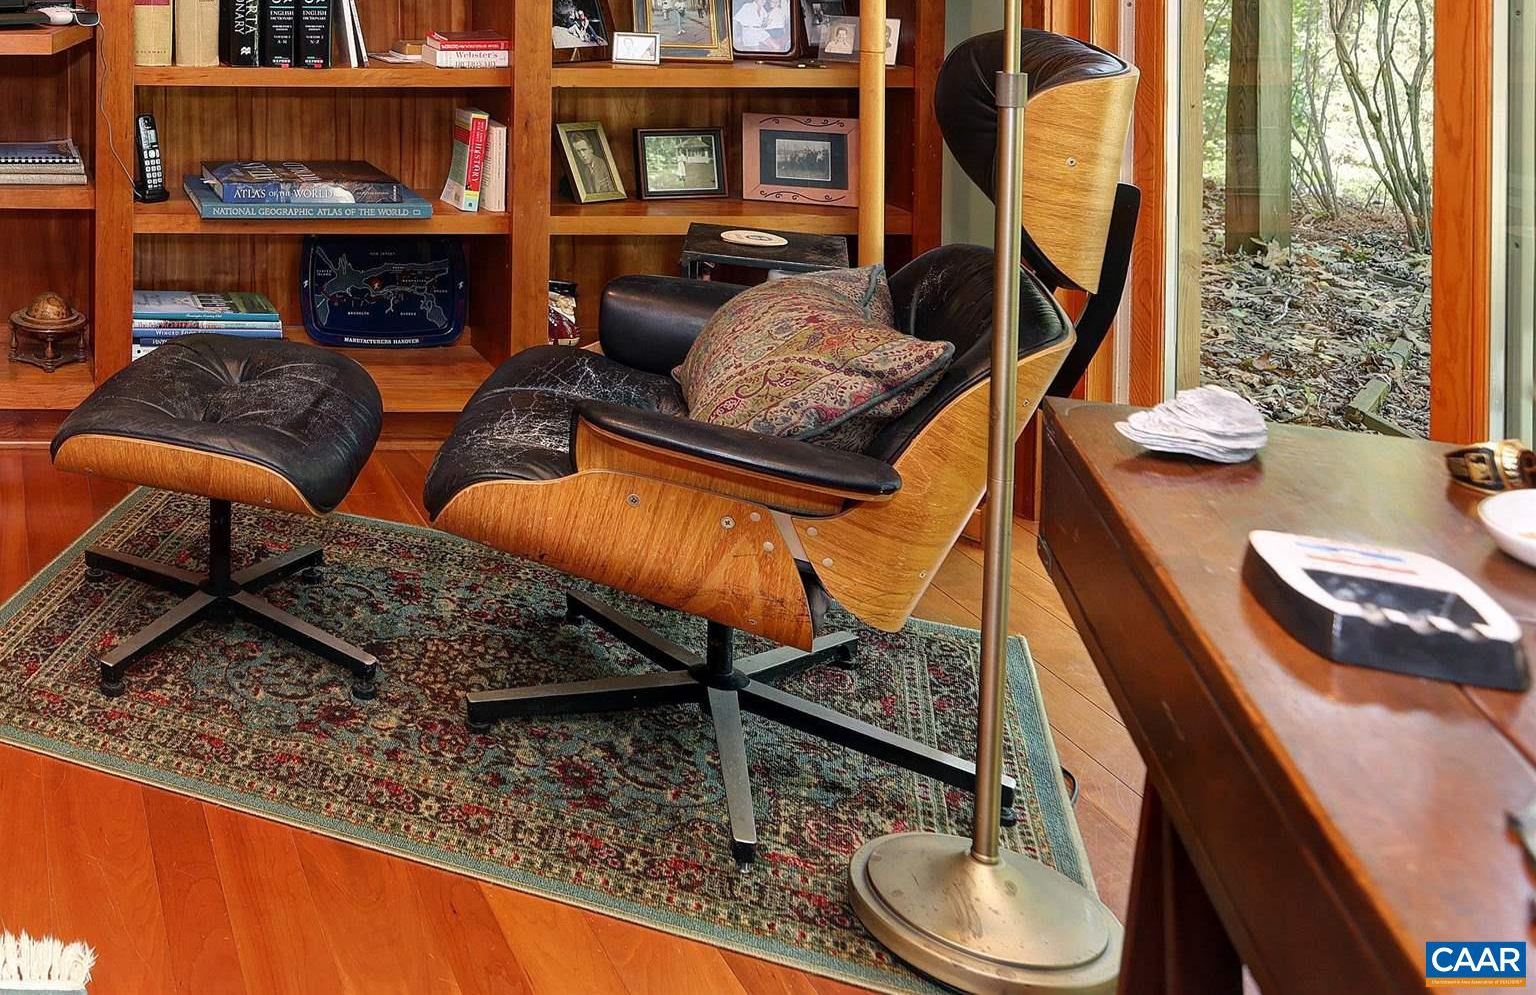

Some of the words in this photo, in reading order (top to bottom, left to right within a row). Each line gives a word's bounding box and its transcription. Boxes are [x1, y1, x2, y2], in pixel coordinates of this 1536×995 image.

[471, 142, 483, 182] HISTORY
[233, 189, 266, 198] ATLAS
[293, 189, 333, 198] WORLD
[258, 208, 313, 216] GEOGRAPHIC
[317, 208, 342, 216] ATLAS
[345, 208, 356, 216] OF
